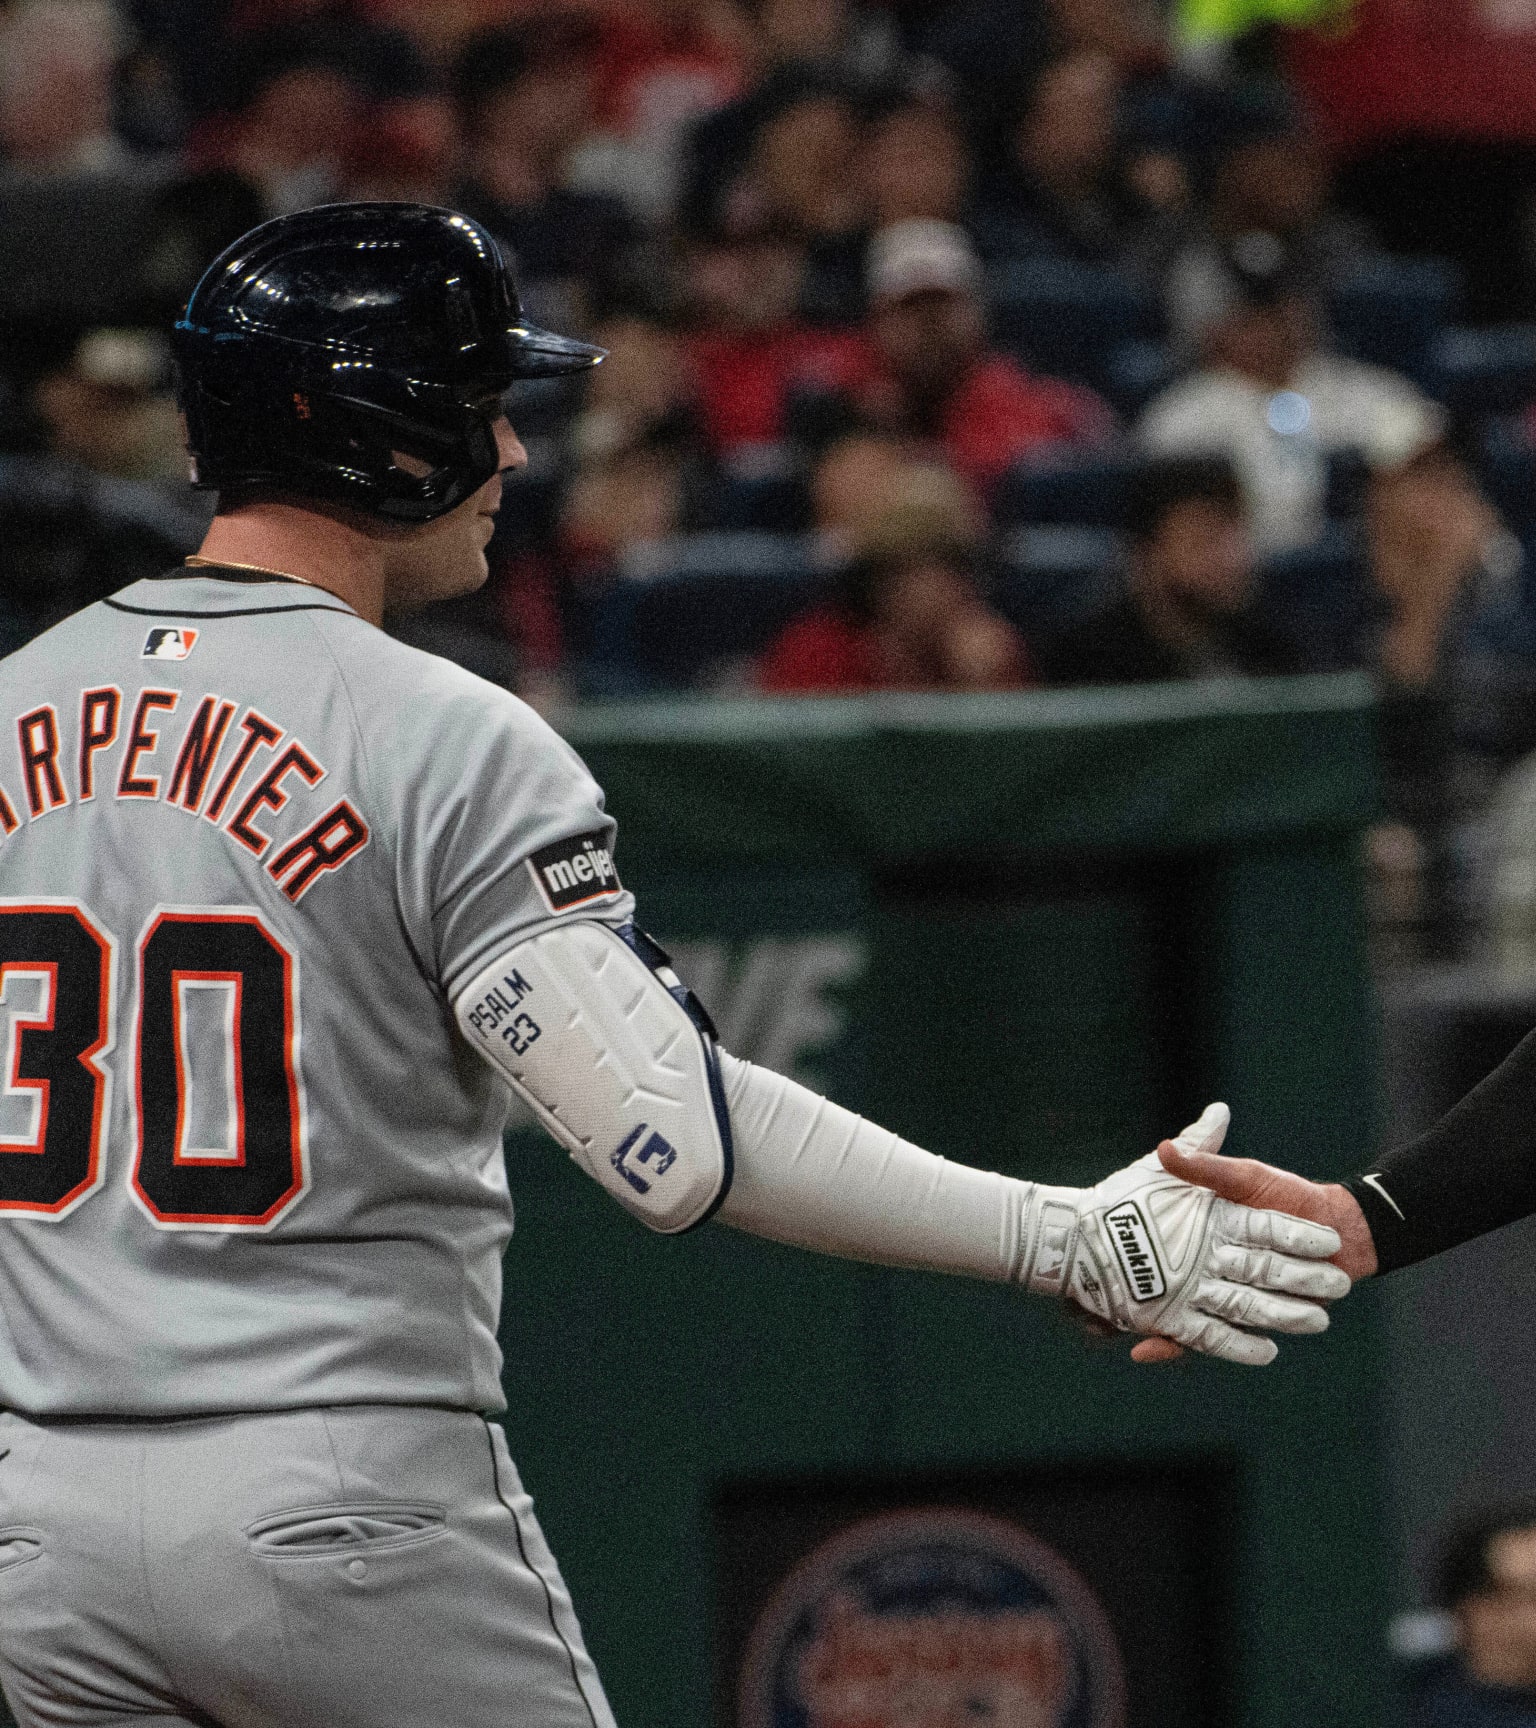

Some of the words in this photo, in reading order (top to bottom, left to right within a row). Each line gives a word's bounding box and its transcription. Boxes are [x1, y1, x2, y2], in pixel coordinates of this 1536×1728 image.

[0, 687, 370, 902] RPENTER
[0, 896, 314, 1234] 30
[468, 968, 534, 1039] PSALM
[502, 1011, 542, 1057] 23
